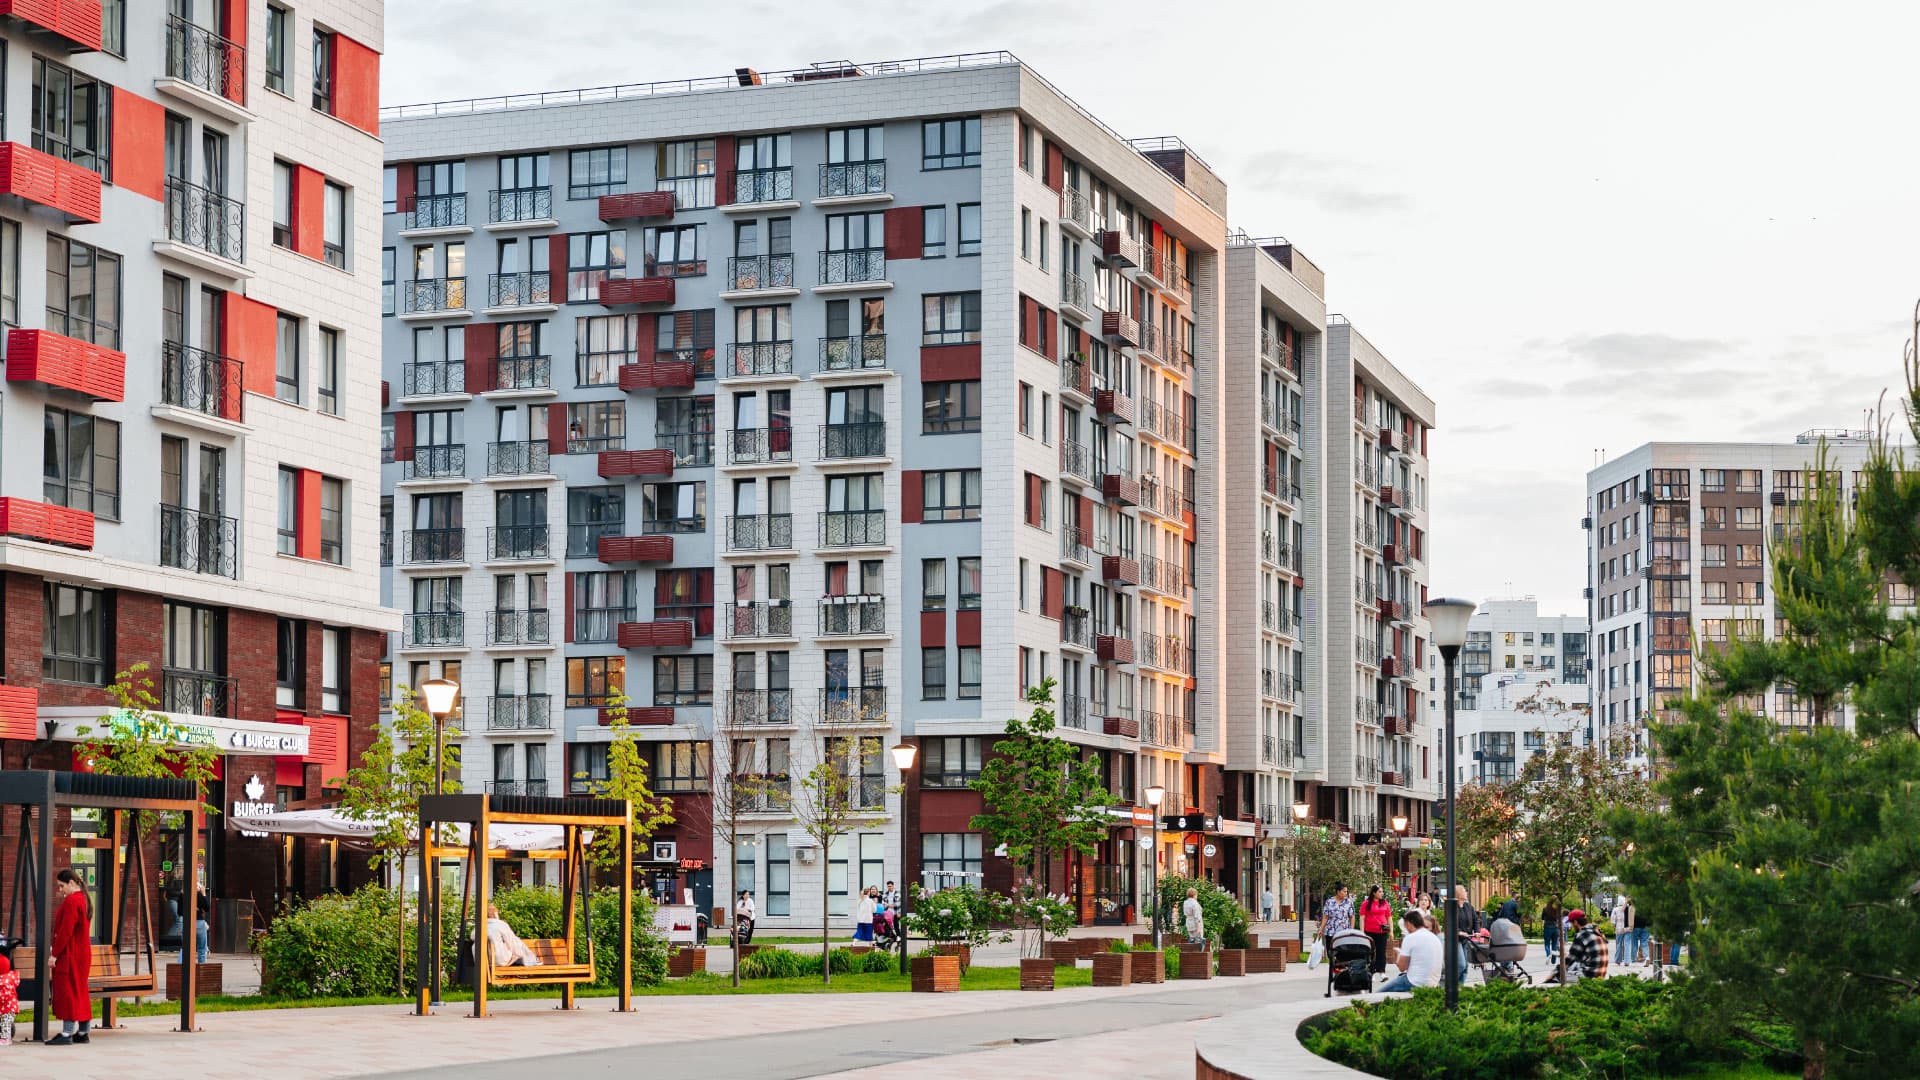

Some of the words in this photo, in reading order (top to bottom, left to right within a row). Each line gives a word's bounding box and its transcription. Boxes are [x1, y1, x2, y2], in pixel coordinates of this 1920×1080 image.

[245, 733, 280, 749] BURGER
[281, 736, 304, 751] CLUB
[249, 819, 281, 827] CANTI
